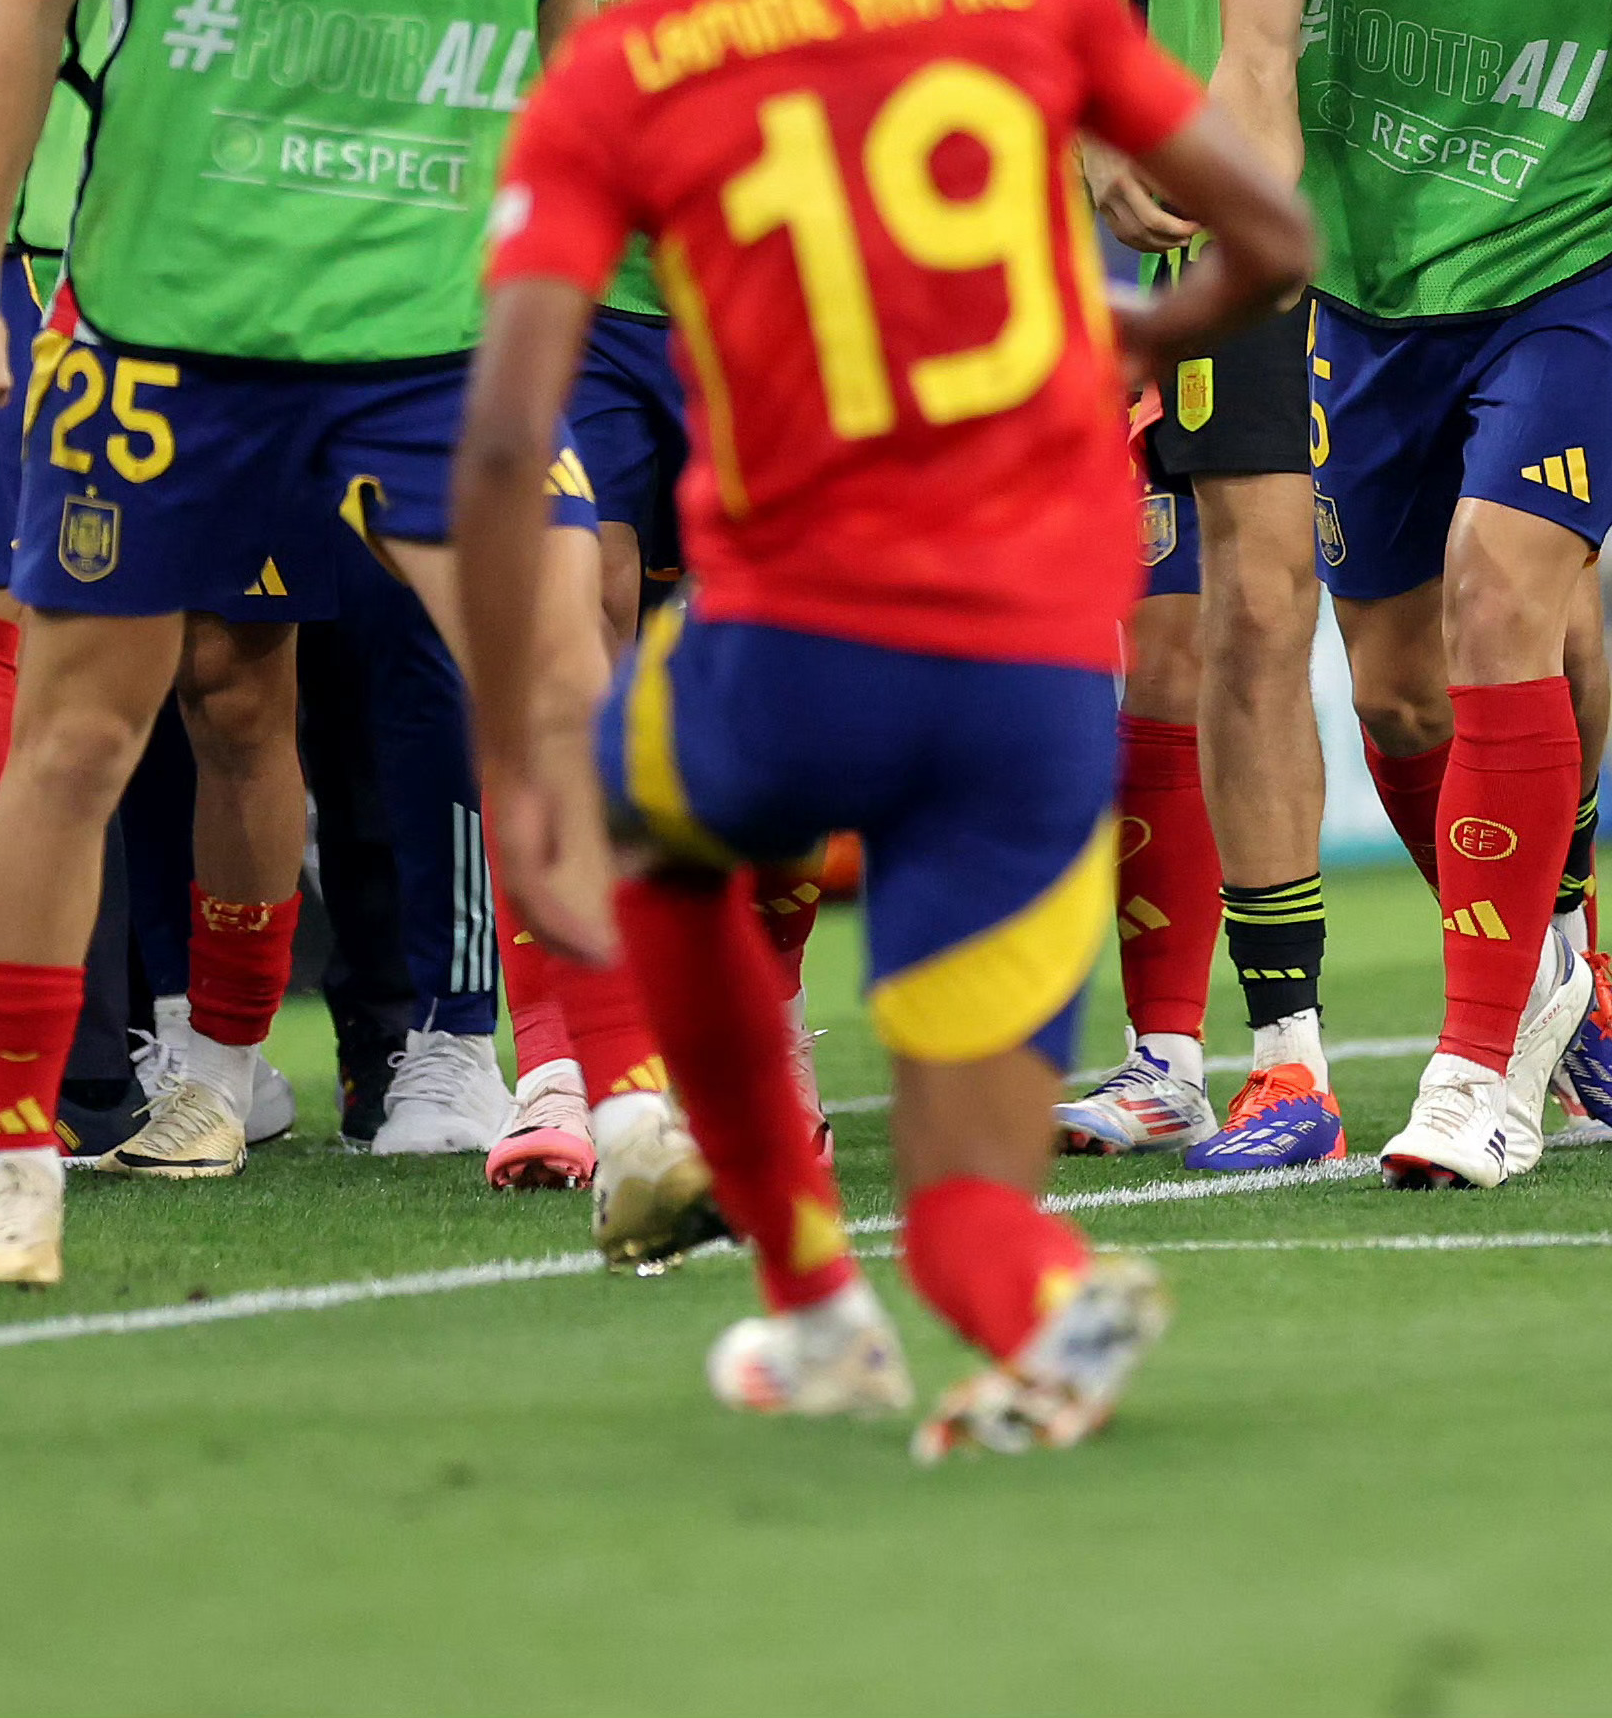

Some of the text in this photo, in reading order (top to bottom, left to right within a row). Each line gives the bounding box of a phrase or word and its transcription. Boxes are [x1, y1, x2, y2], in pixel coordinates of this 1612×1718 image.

[280, 134, 469, 195] RESPECT
[1372, 110, 1539, 189] RESPECT
[719, 58, 1067, 442] 19
[50, 348, 182, 484] 25
